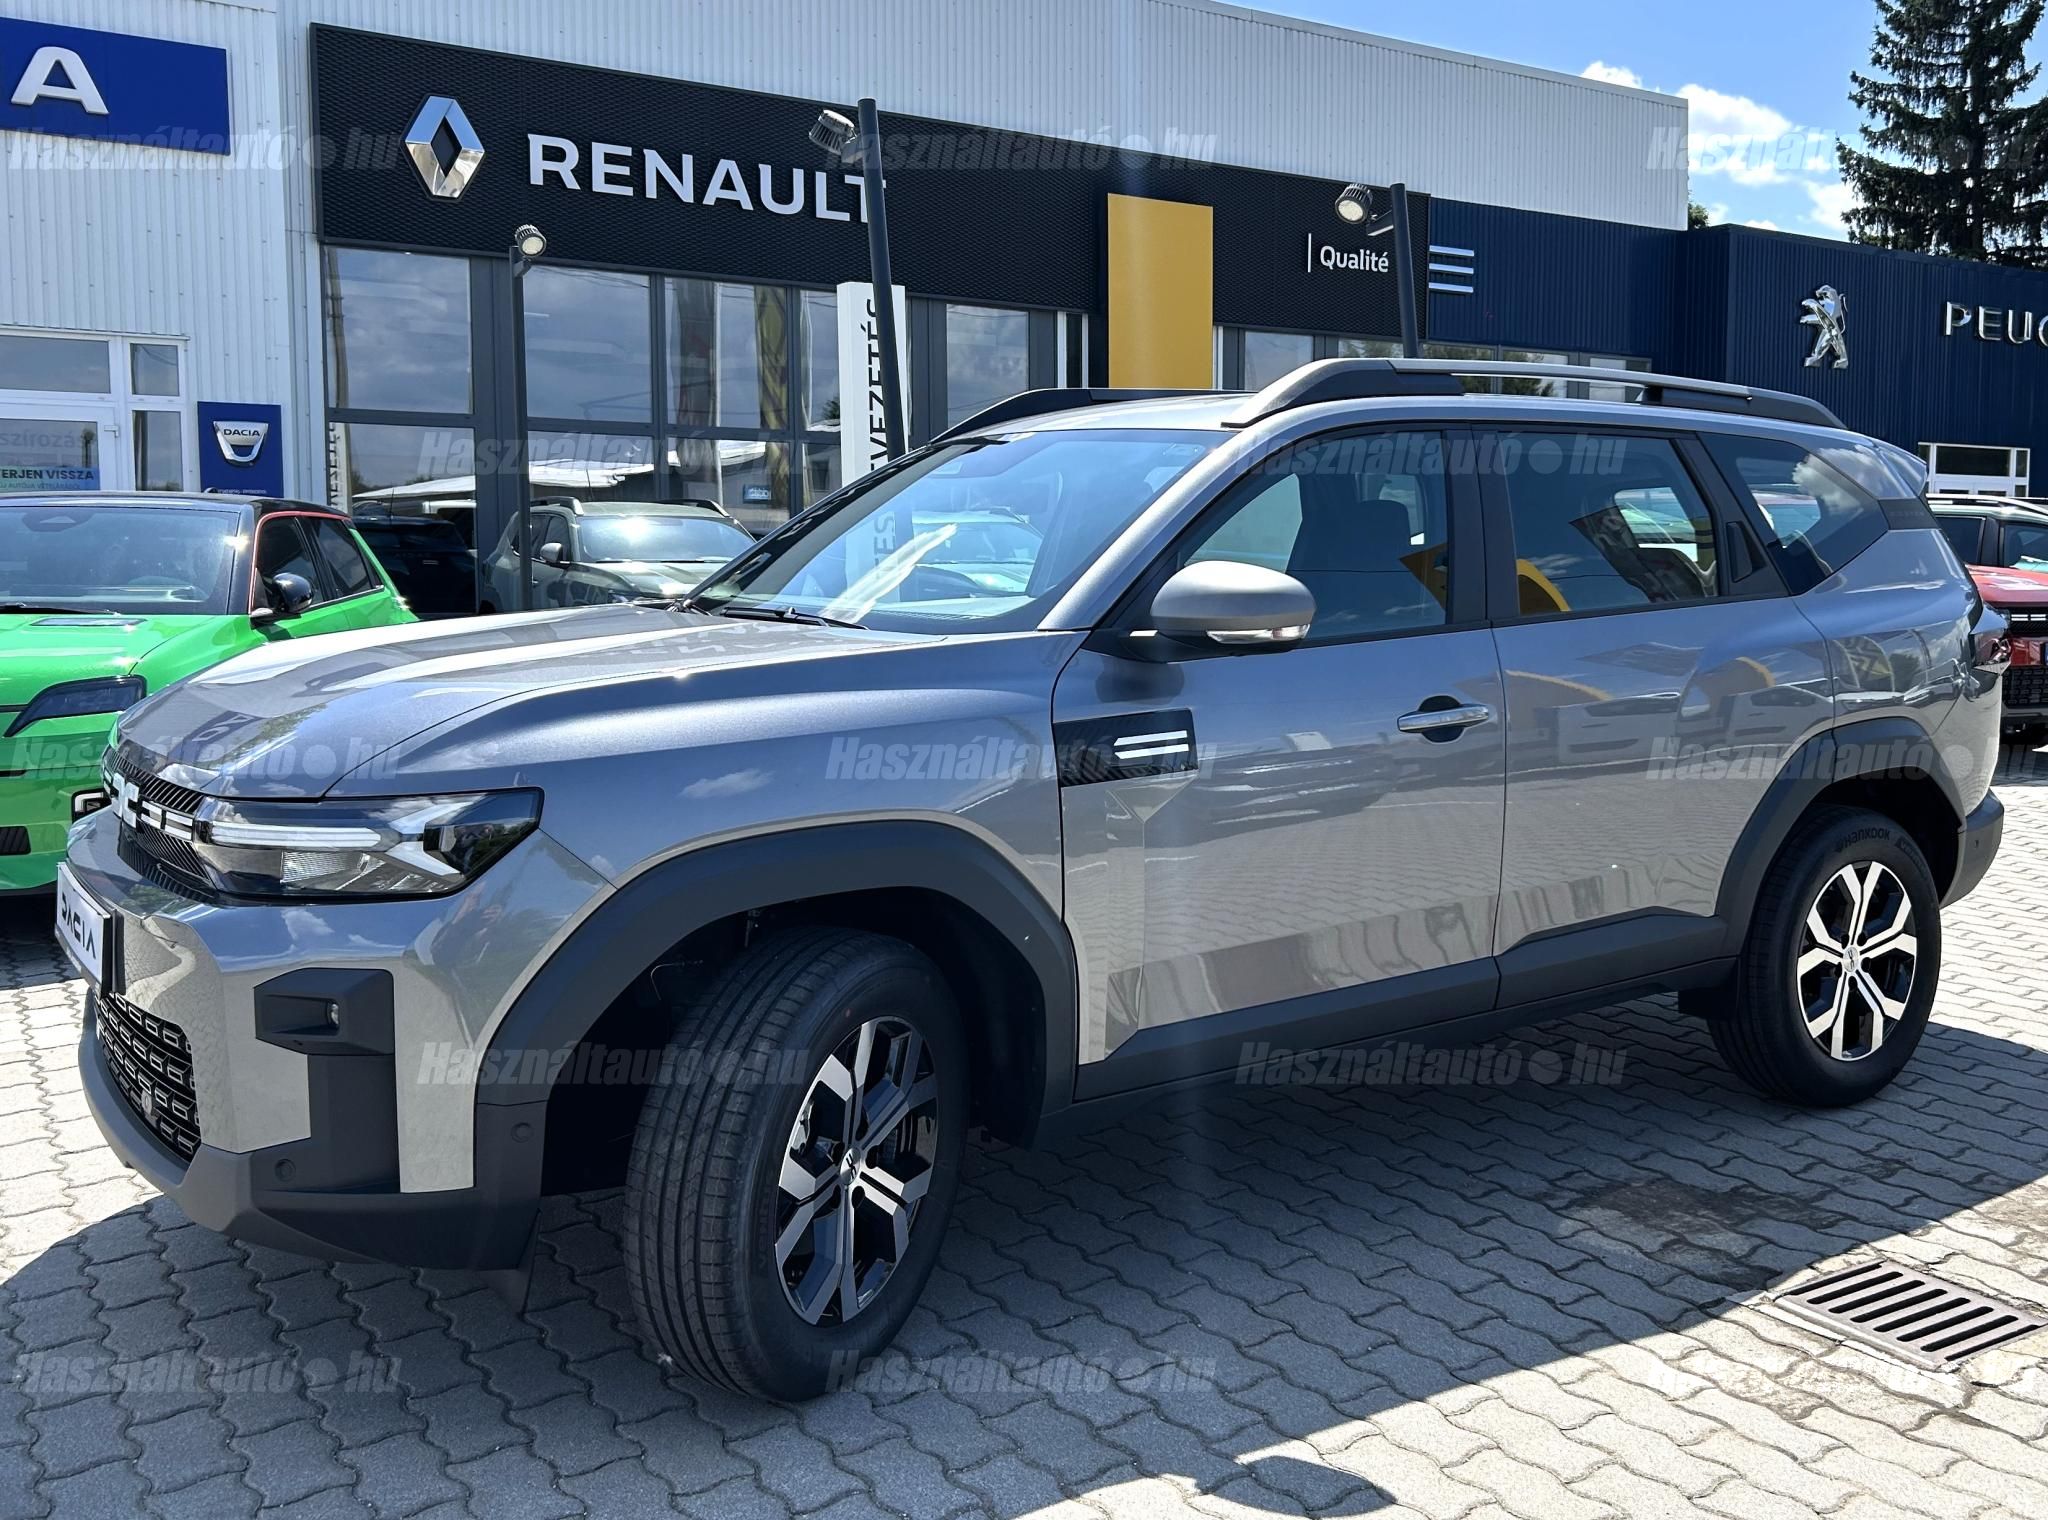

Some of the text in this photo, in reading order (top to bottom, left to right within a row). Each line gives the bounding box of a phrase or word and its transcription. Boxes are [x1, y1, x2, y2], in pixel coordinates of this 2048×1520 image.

[11, 46, 109, 115] A
[528, 133, 886, 223] RENAULT
[1320, 245, 1389, 273] Qualité
[223, 428, 261, 437] DACIA
[0, 469, 94, 481] ERJEN VISSZA
[61, 891, 97, 960] DACIA
